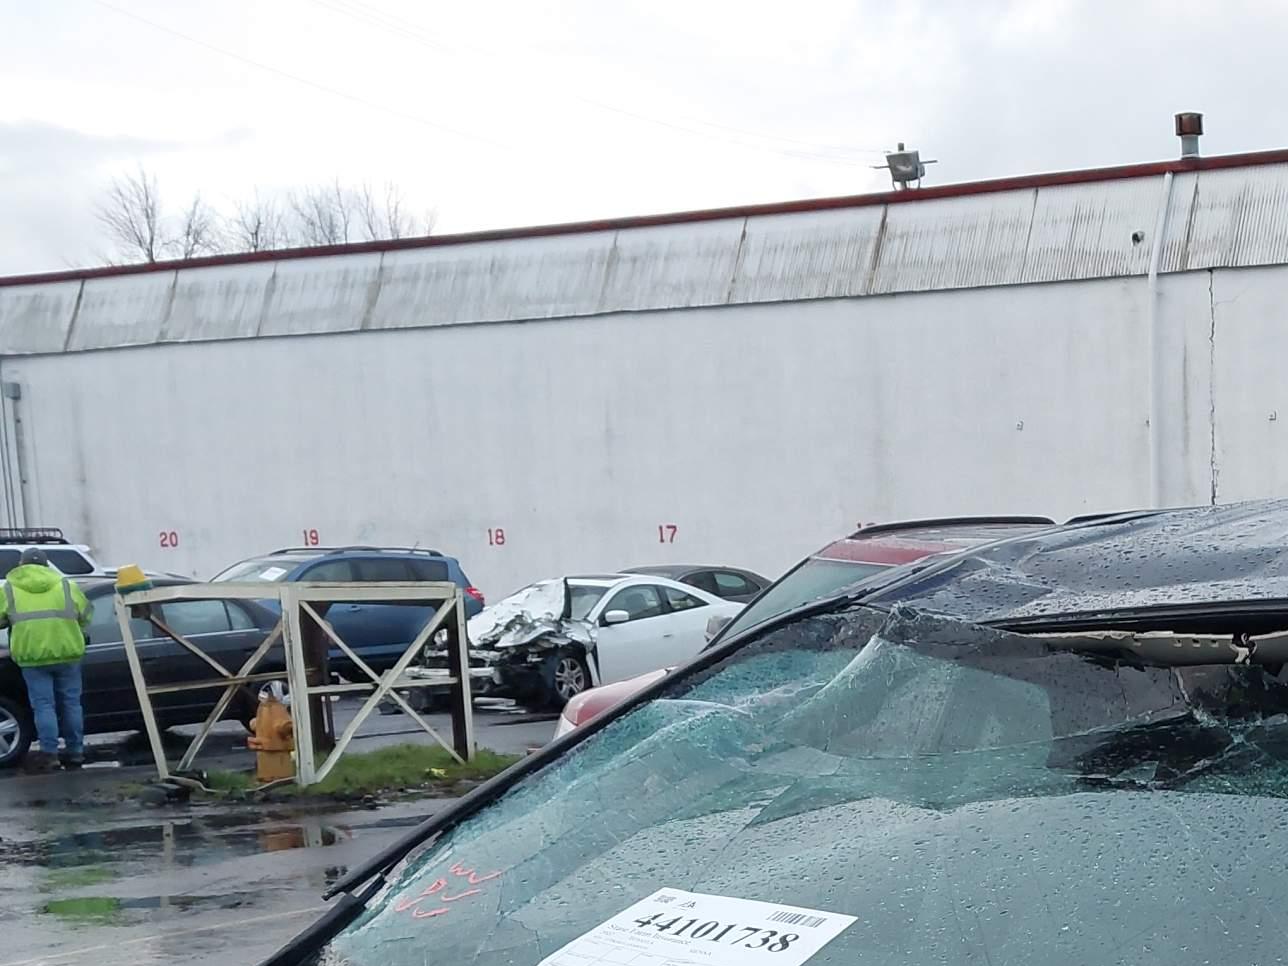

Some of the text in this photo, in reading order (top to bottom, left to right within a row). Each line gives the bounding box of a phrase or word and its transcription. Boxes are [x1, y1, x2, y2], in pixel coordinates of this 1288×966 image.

[159, 531, 179, 548] 20
[303, 528, 320, 547] 19
[487, 527, 506, 546] 18
[658, 524, 678, 544] 17
[632, 912, 801, 953] 44101738
